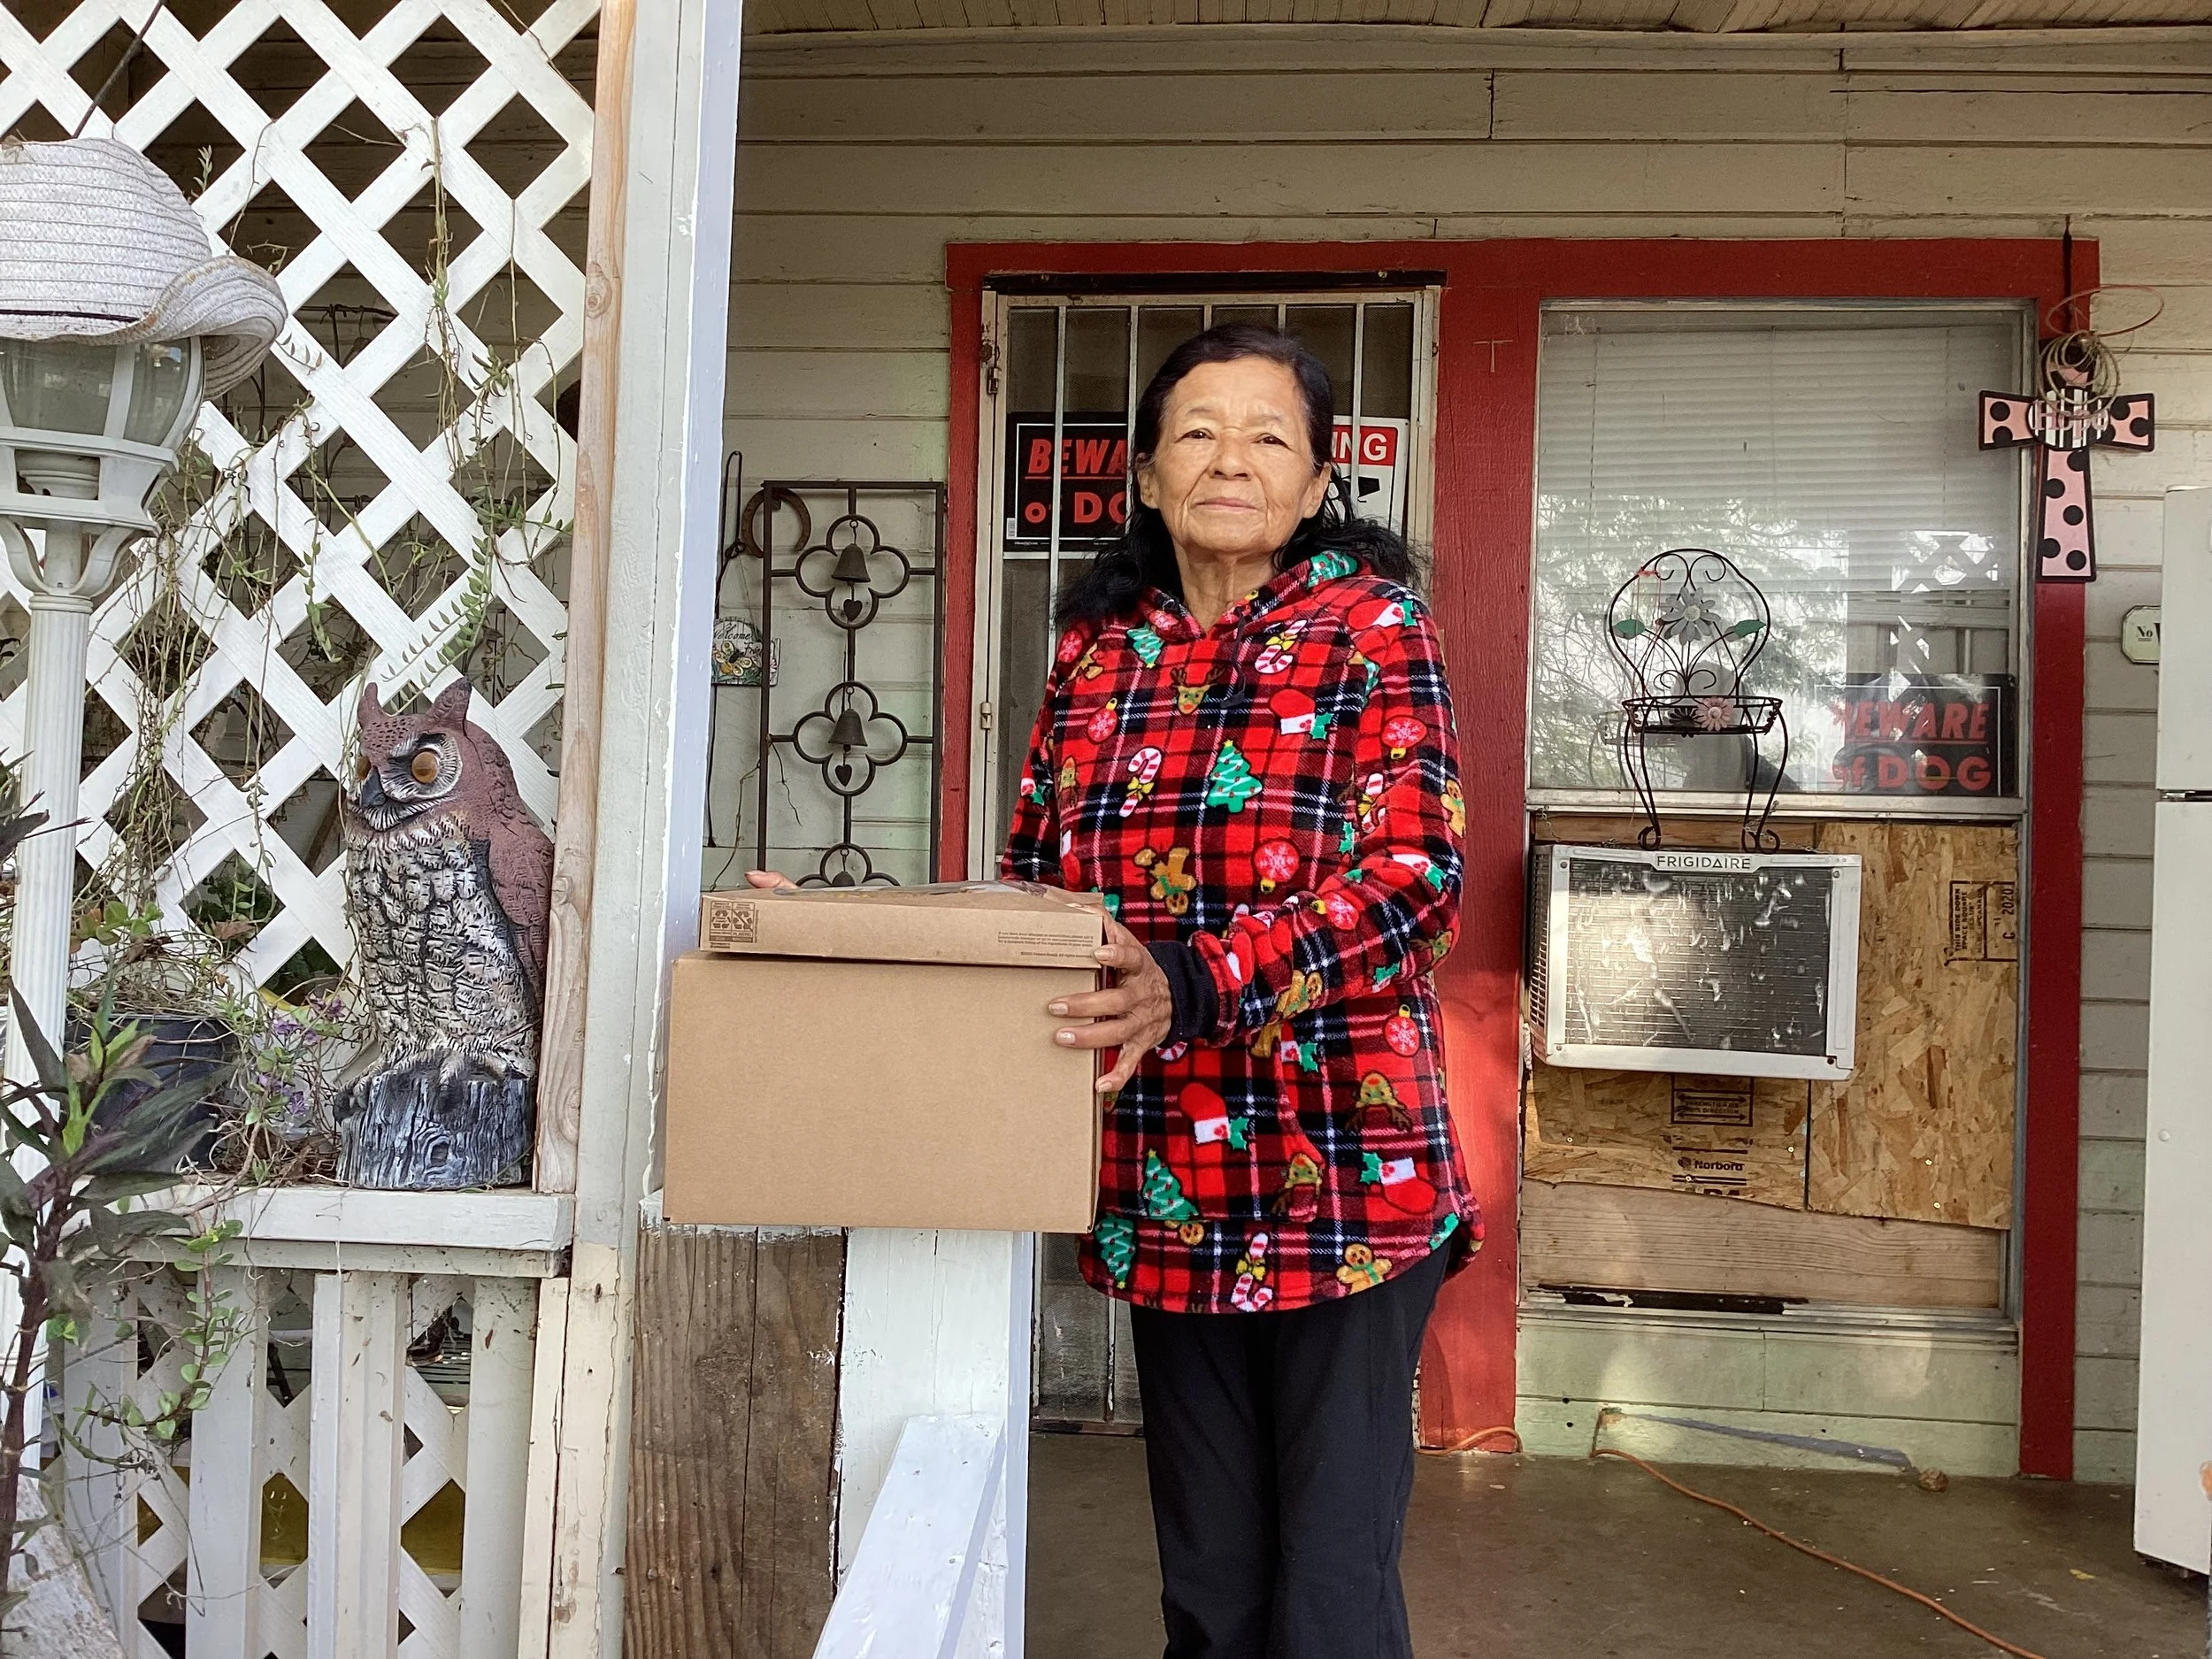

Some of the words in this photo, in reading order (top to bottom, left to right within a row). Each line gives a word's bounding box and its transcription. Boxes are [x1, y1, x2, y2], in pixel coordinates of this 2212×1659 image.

[2033, 400, 2108, 440] Hope
[1028, 439, 1127, 473] BEWA
[1074, 491, 1127, 524] DO
[1828, 700, 1990, 740] BEWARE
[1878, 755, 1991, 791] DOG
[1656, 856, 1751, 870] FRIGIDAIRE
[2001, 888, 2015, 915] 2020
